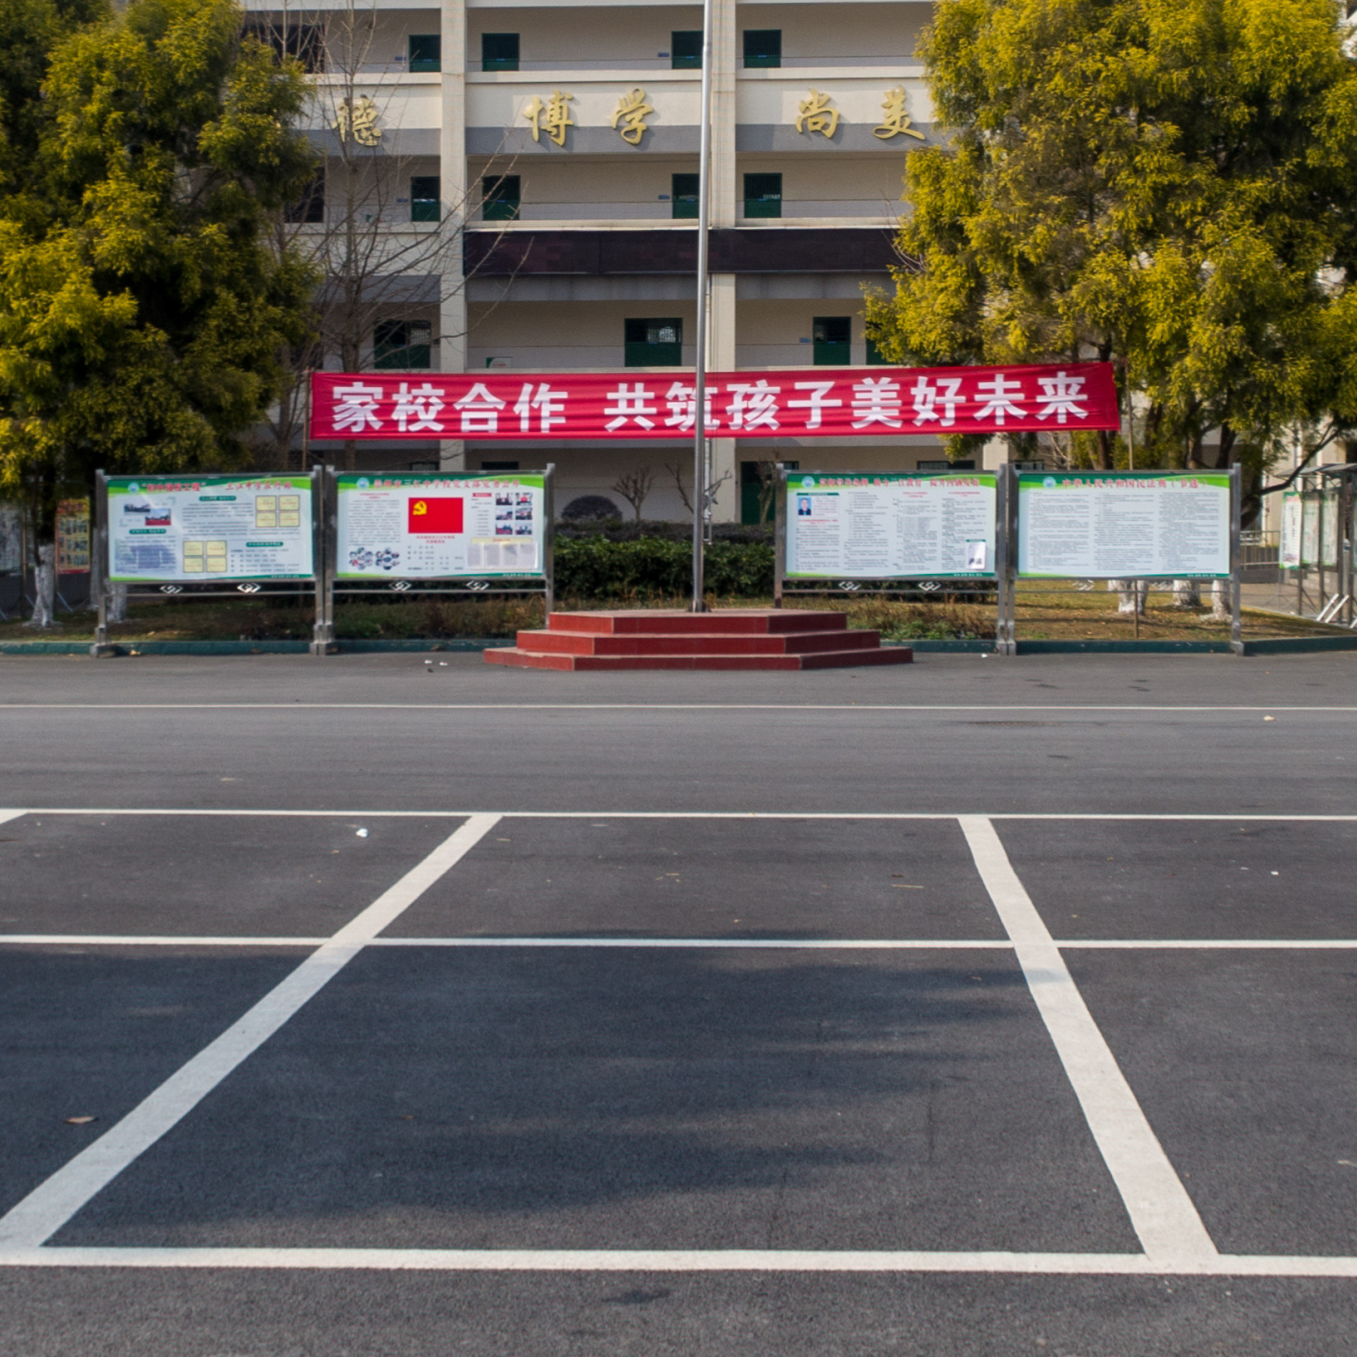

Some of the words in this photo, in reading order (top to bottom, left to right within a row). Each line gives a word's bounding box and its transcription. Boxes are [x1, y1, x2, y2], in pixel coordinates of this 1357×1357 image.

[524, 88, 655, 147] 博学
[795, 85, 927, 142] 尚美
[332, 381, 569, 433] 家校合作
[604, 371, 1089, 432] 共筑孩子美好未来
